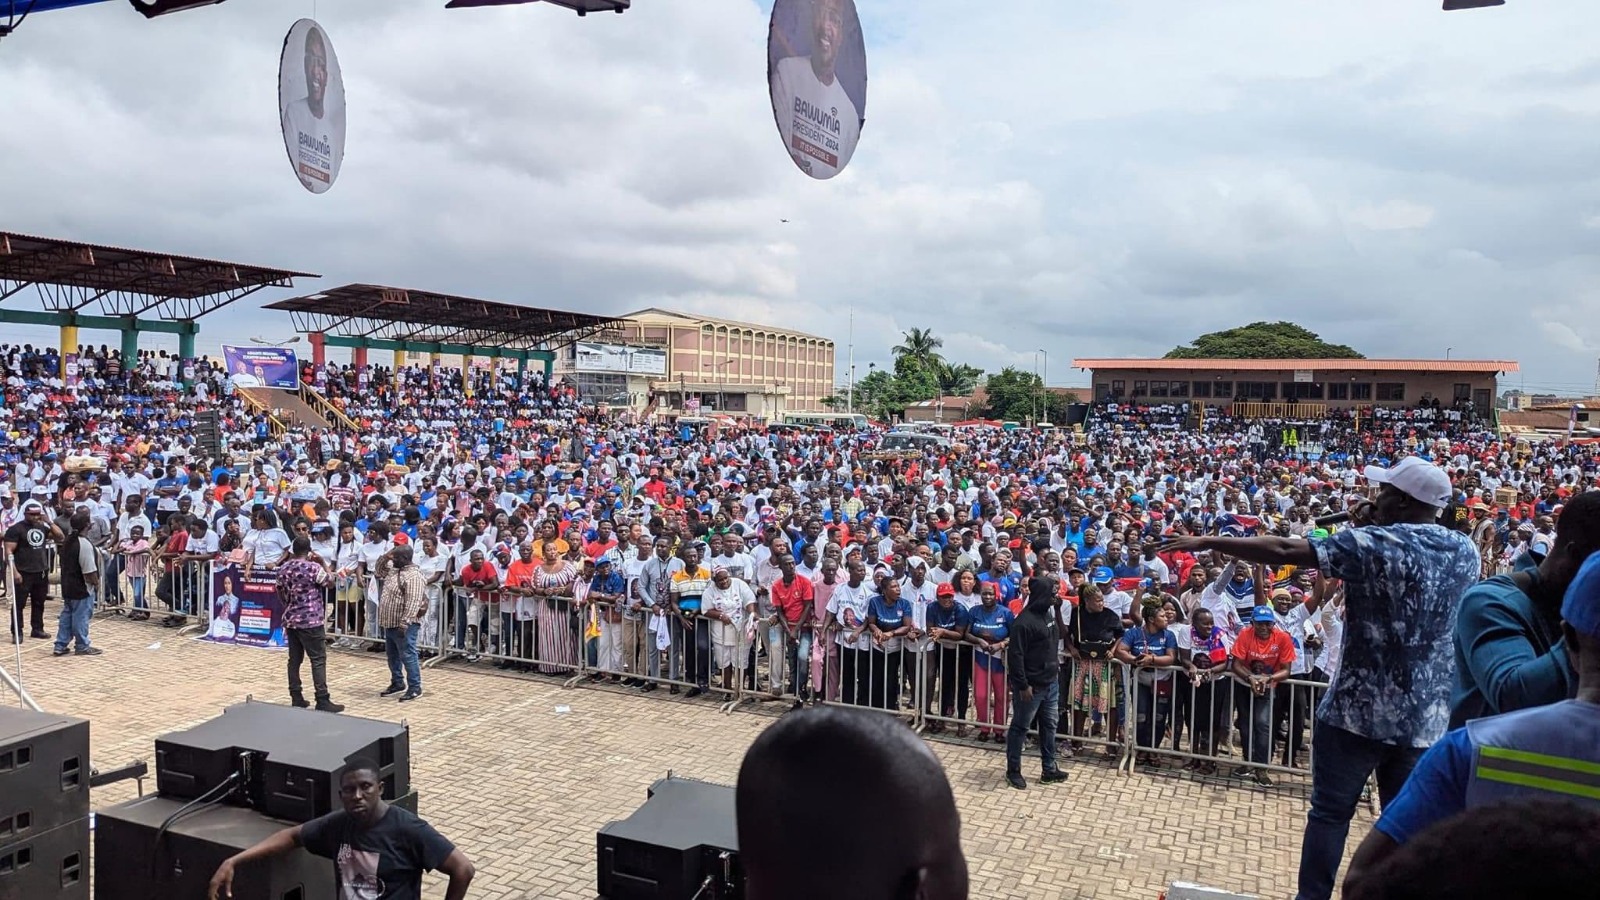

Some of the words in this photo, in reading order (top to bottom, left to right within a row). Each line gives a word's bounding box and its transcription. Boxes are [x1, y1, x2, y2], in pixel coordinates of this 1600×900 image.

[795, 97, 840, 135] BAWUMIA
[299, 132, 330, 157] BAWUMIA
[793, 120, 825, 143] PRESIDENT
[826, 137, 839, 151] 2024
[809, 146, 830, 161] POSSIBLE
